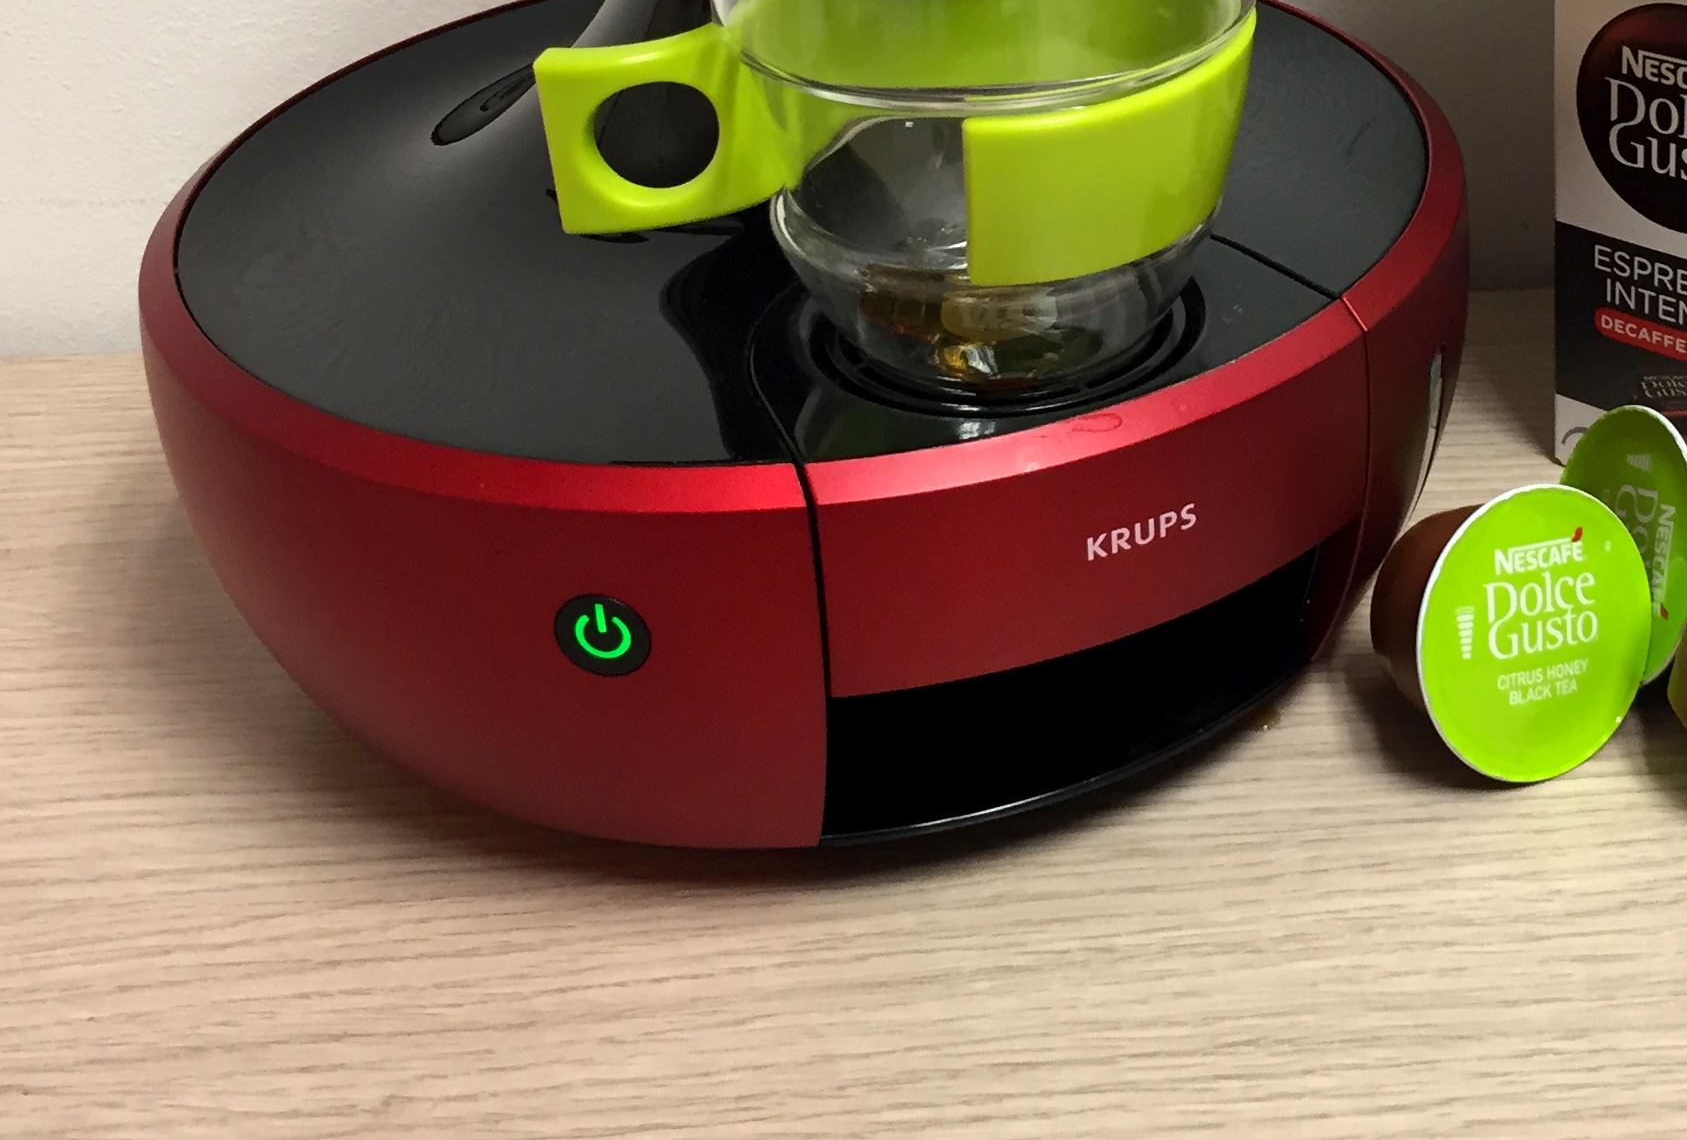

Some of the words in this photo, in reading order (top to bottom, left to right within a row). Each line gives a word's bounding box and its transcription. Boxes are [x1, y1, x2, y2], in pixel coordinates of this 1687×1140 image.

[1609, 123, 1687, 180] Gu
[1601, 314, 1686, 354] DECAFFE
[1087, 503, 1197, 561] KRUPS
[1483, 571, 1595, 624] Dolce
[1488, 609, 1599, 660] Gusto
[1497, 668, 1544, 691] CITRUS
[1547, 658, 1589, 679] HONEY
[1509, 684, 1552, 706] BLACK
[1556, 679, 1578, 696] TEA
